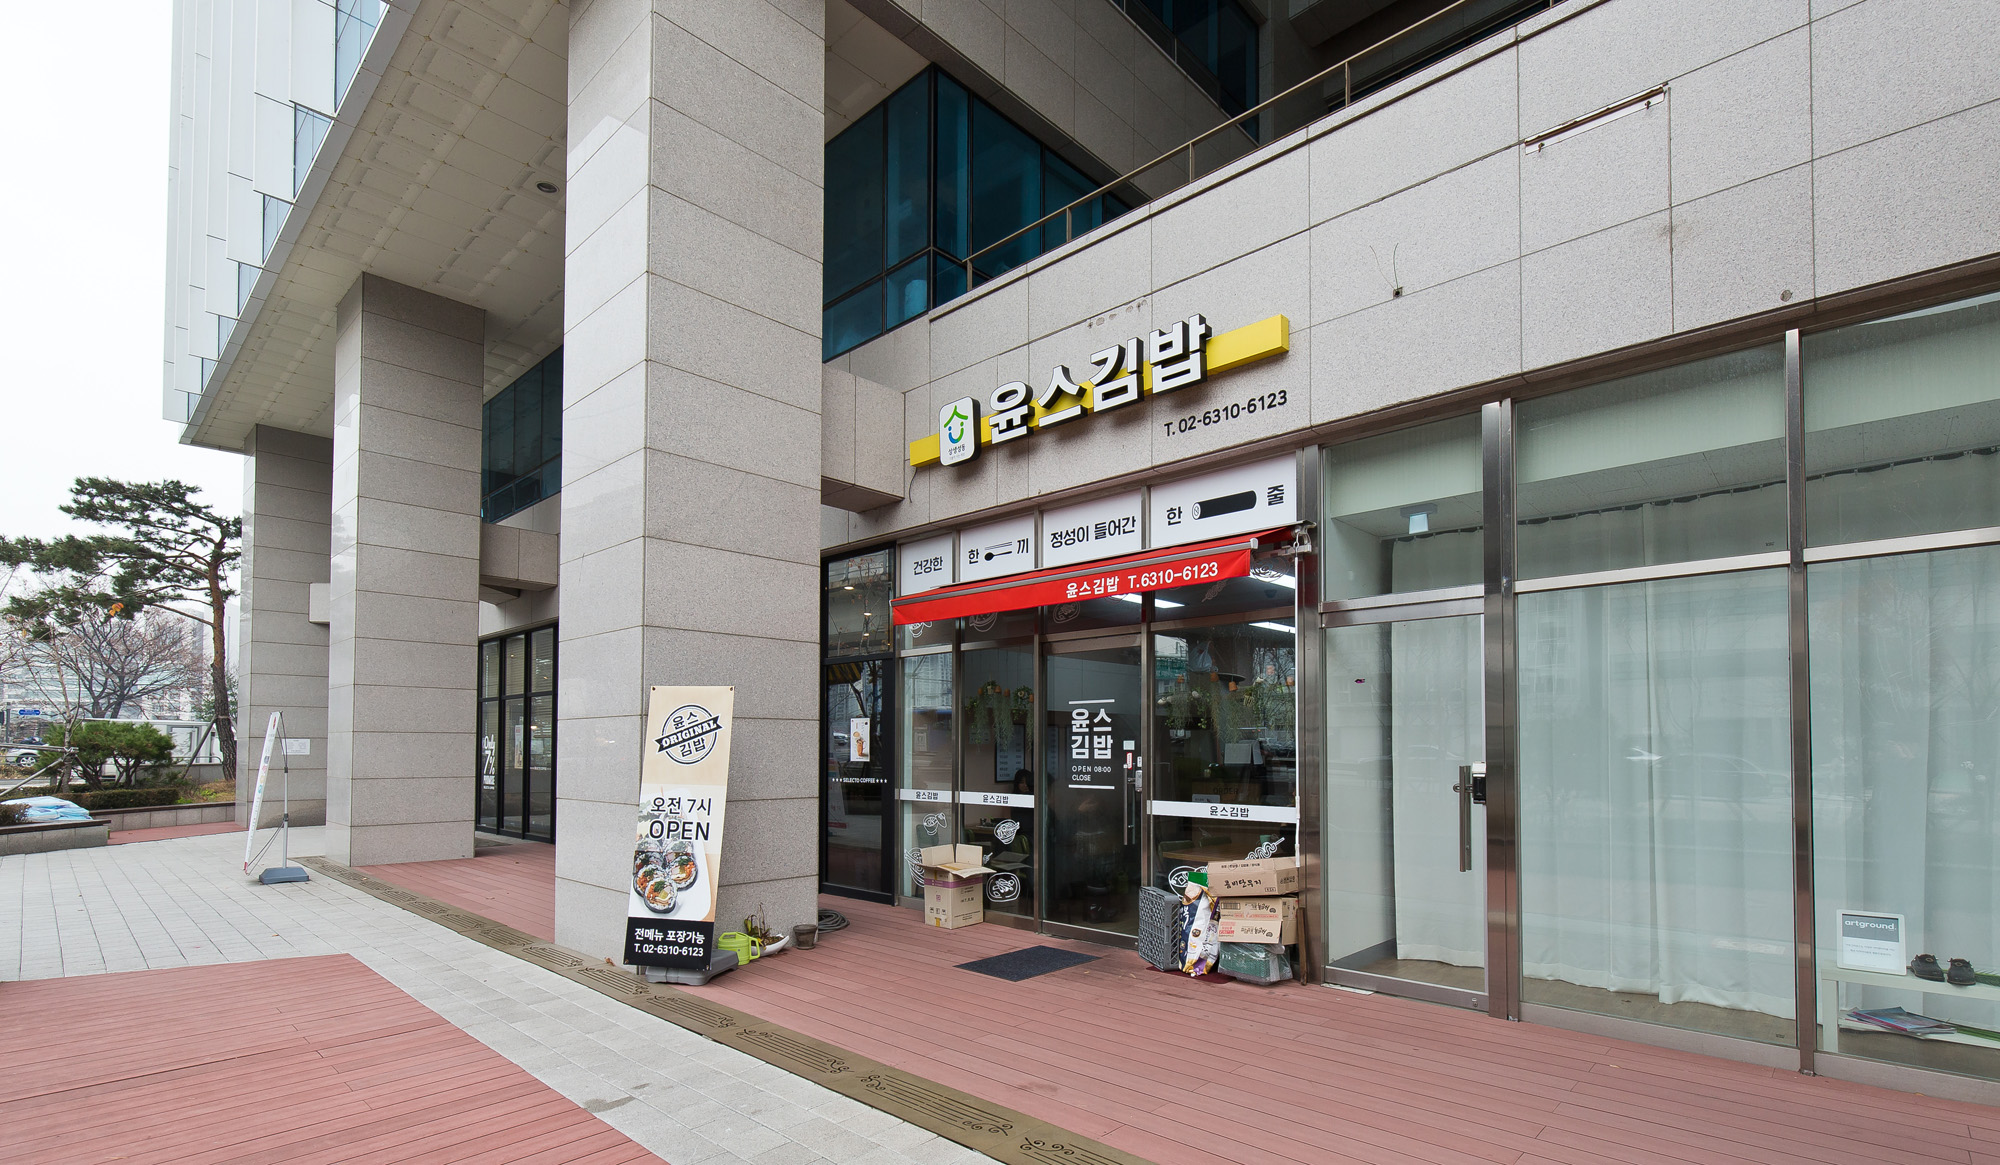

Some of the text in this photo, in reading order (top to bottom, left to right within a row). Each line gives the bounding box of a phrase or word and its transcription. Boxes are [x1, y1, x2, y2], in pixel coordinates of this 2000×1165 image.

[989, 313, 1212, 444] 윤스김밥
[1164, 389, 1288, 439] T. 02-6310-6123
[1166, 484, 1285, 526] 한 줄
[1050, 515, 1137, 549] 정성이 들어간
[968, 538, 1029, 565] 한 끼
[913, 556, 943, 576] 건강한
[1065, 561, 1219, 600] 윤스김밥 T.6310-6123
[672, 711, 699, 730] 윤스
[1071, 708, 1112, 733] 윤스
[661, 719, 717, 747] ORIGINAL
[679, 737, 706, 758] 김밥
[1070, 734, 1114, 759] 김밥
[484, 750, 495, 775] 7%
[1071, 765, 1092, 773] OPEN
[1071, 774, 1092, 782] CLOSE
[650, 796, 712, 817] 오전 7시
[915, 790, 939, 801] 윤스김밥
[982, 793, 1009, 804] 윤스김밥
[1210, 805, 1250, 818] 윤스김밥
[648, 819, 711, 843] OPEN
[634, 927, 706, 945] 전메뉴 포장가능
[633, 943, 704, 957] T. 02-6310-6123
